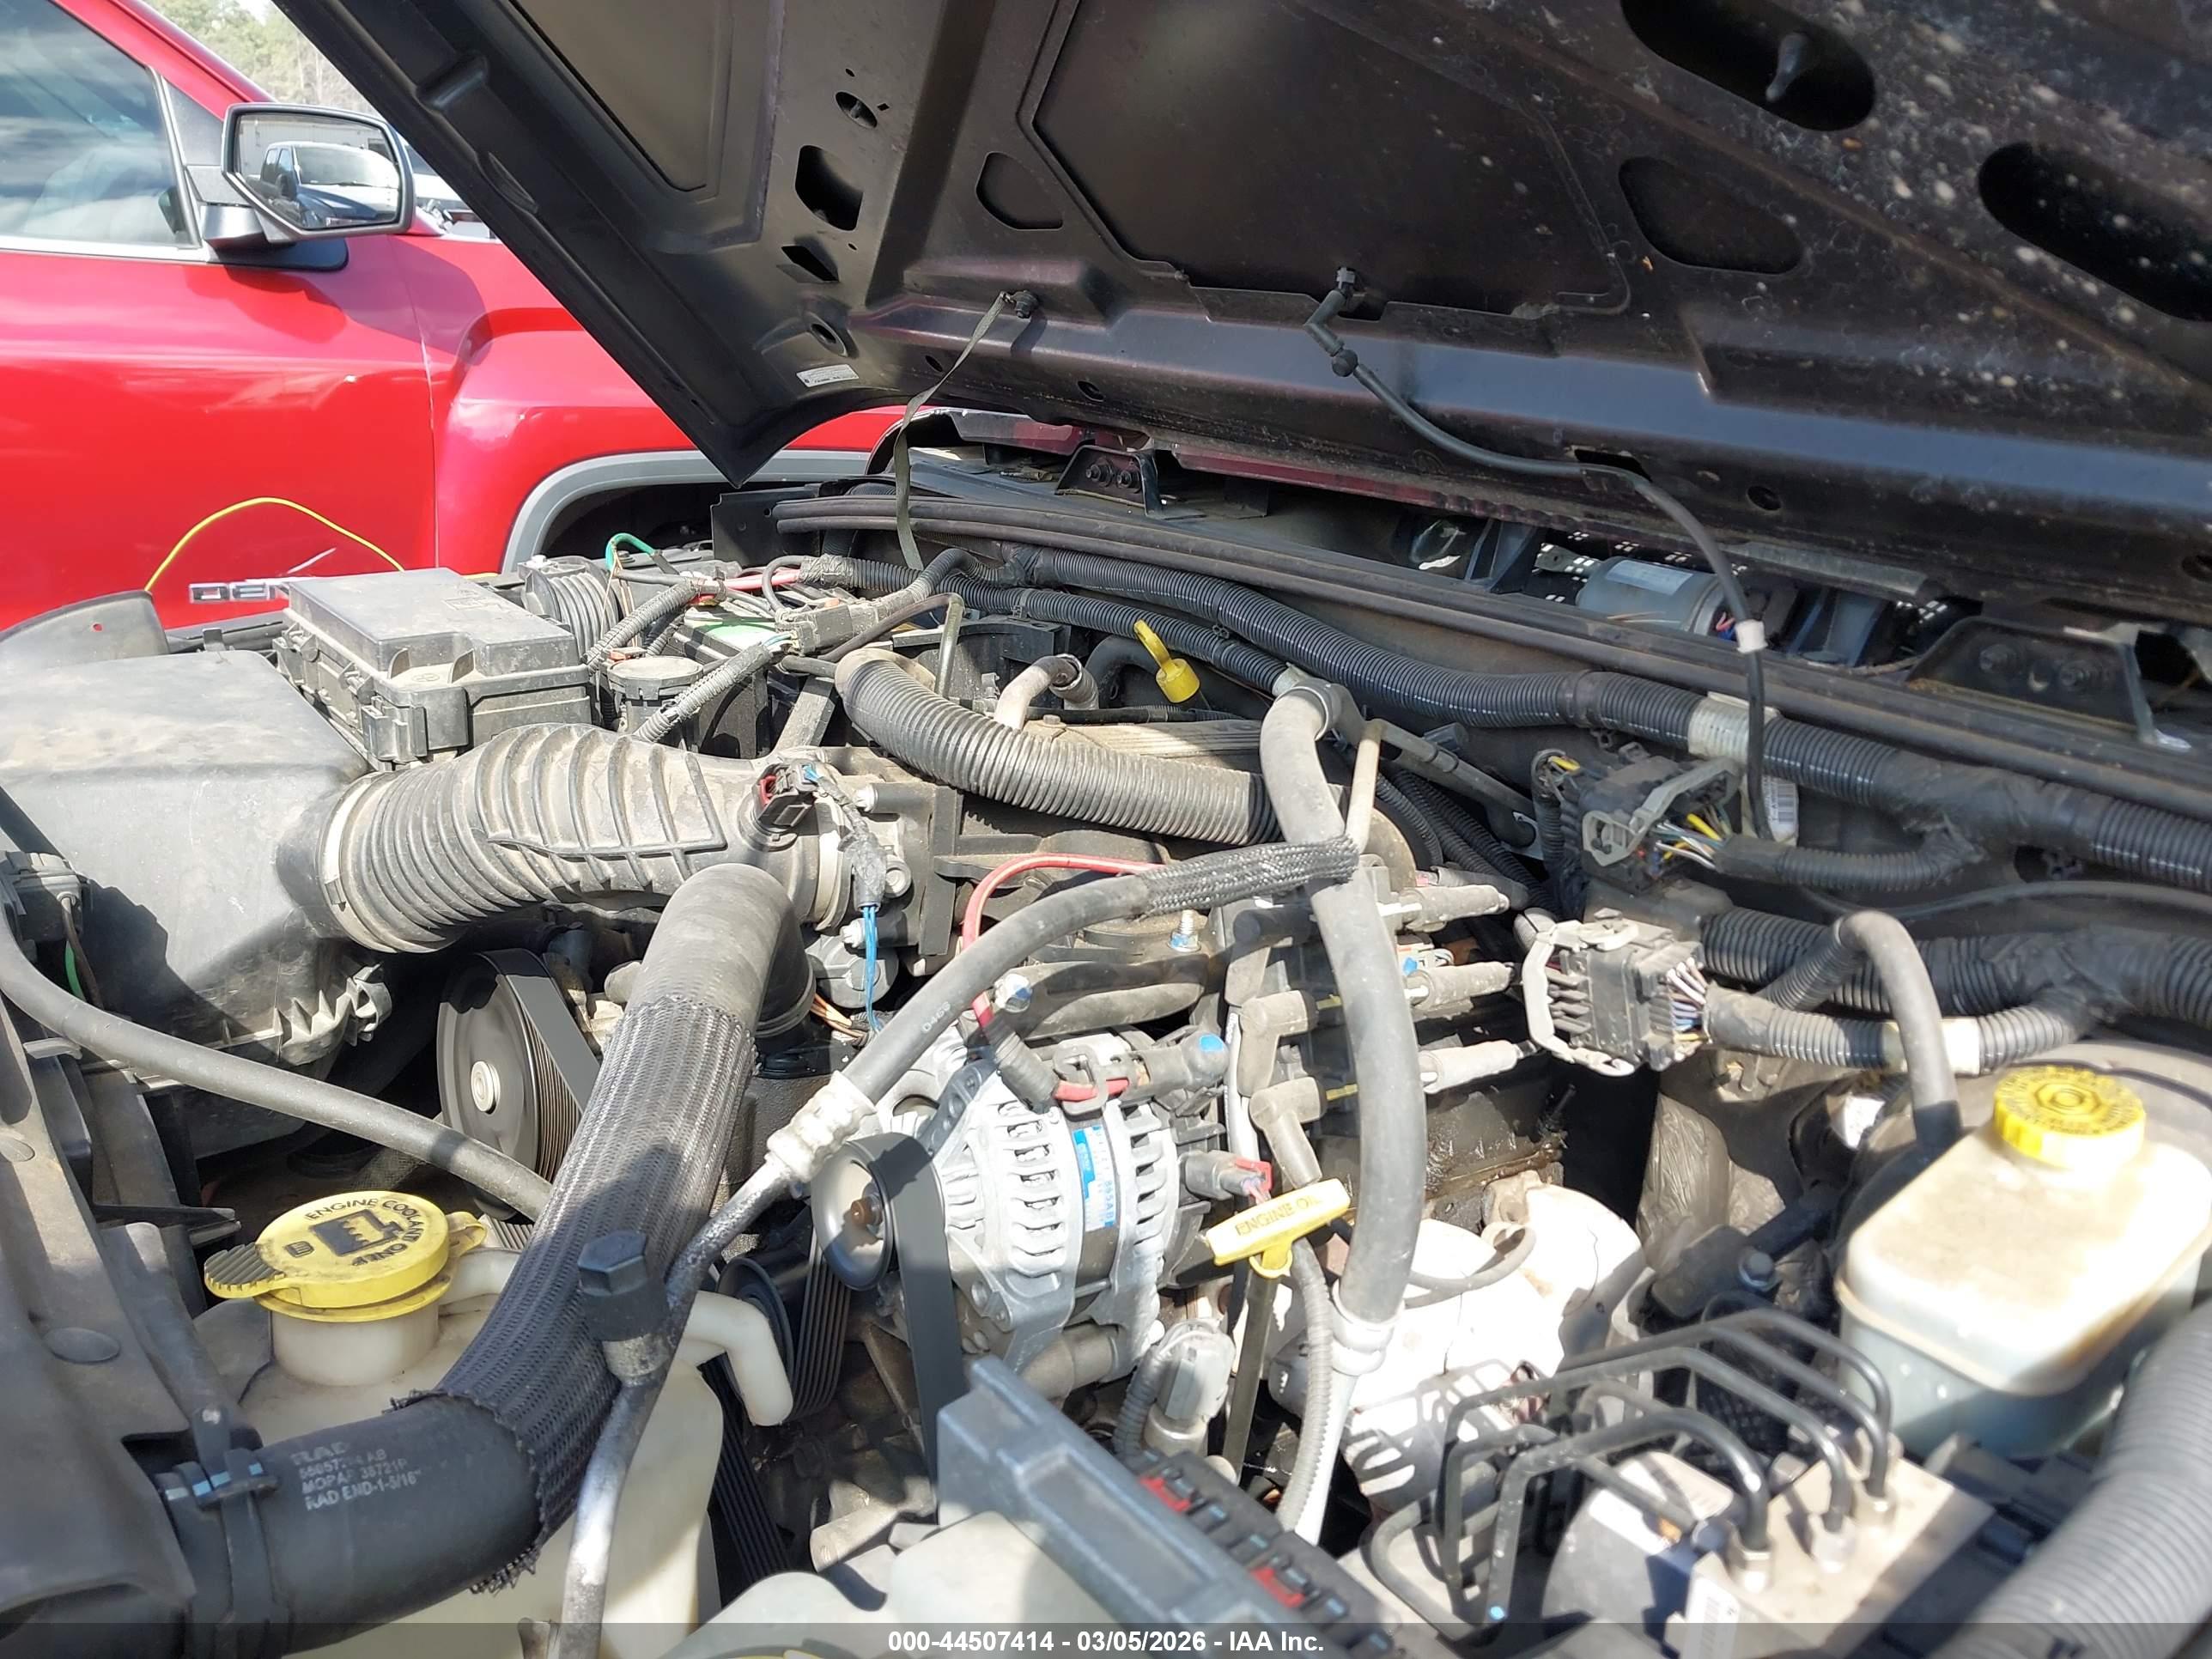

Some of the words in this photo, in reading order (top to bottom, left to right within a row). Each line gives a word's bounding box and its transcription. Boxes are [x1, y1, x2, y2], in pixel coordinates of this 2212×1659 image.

[305, 1198, 378, 1220] ENGINE
[381, 1200, 424, 1243] COOLANT
[1235, 1202, 1295, 1236] ENGINE
